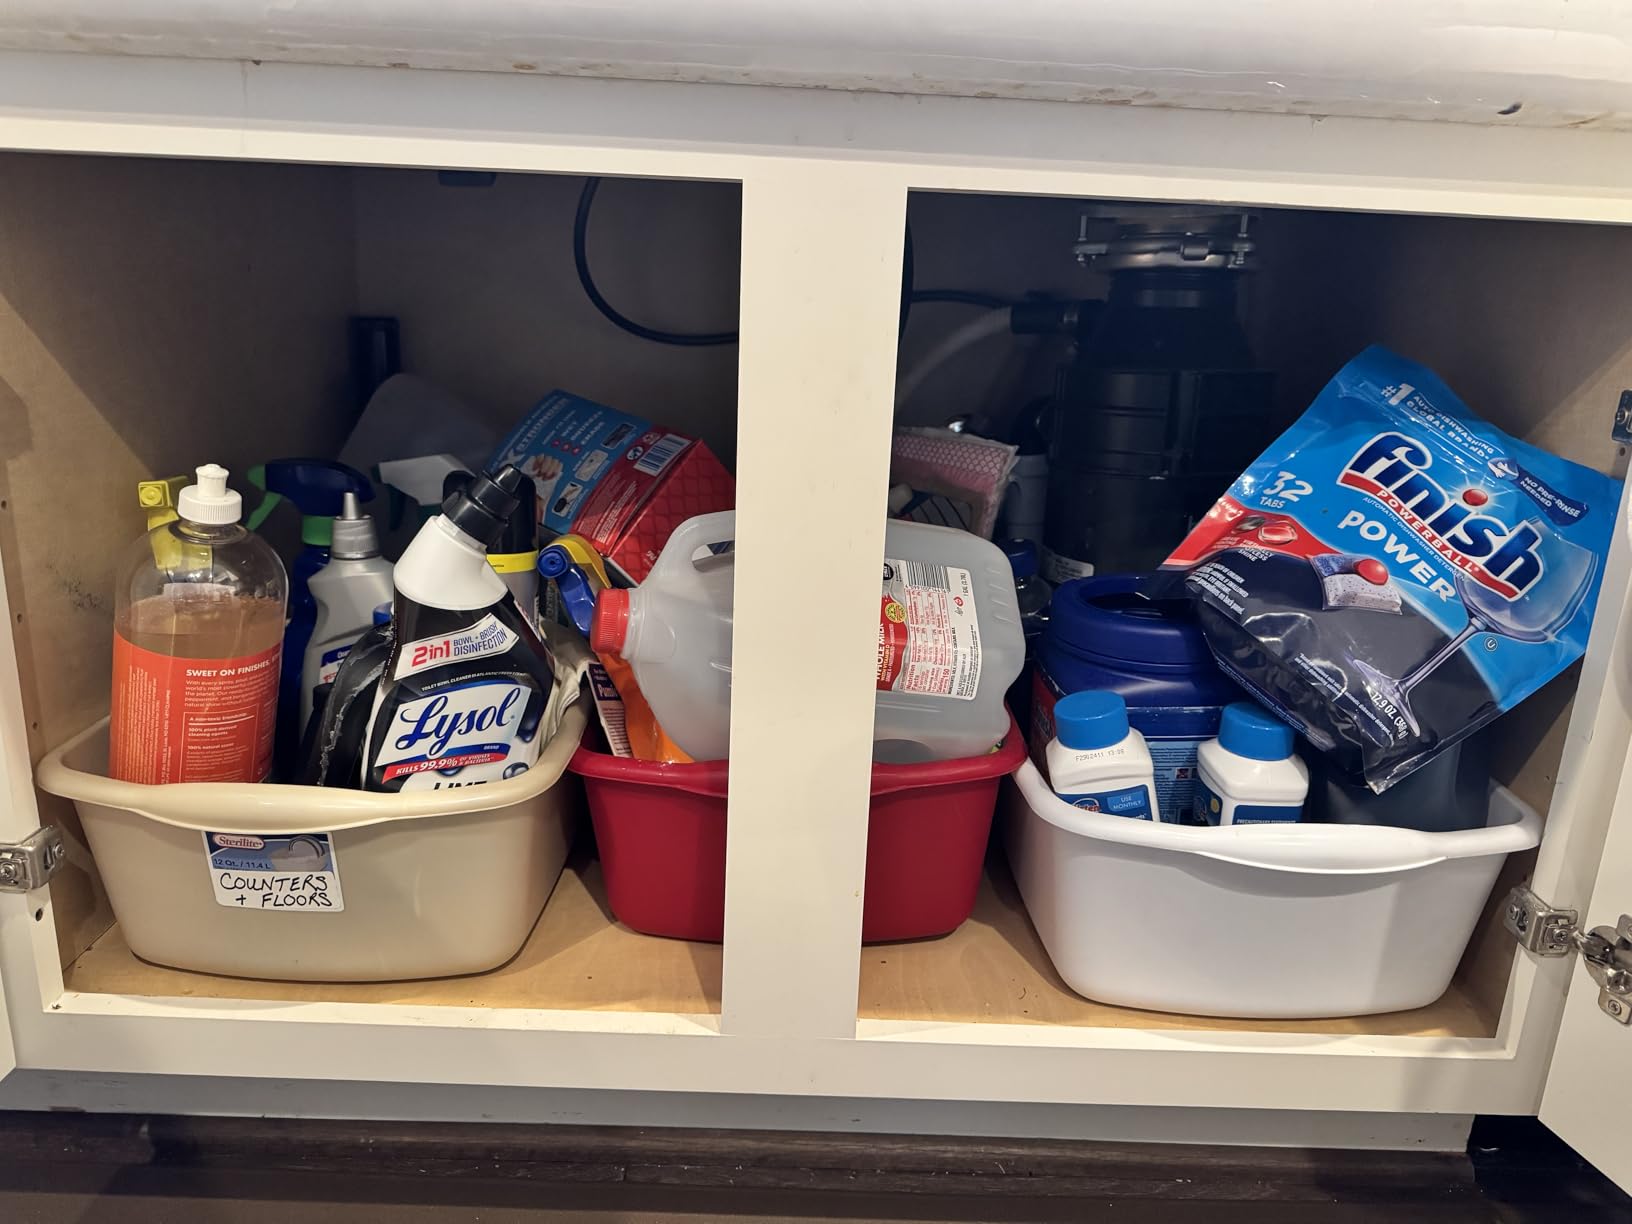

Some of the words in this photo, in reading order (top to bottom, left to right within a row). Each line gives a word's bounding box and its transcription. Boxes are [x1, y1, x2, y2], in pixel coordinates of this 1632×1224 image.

[1380, 383, 1415, 405] #1
[1406, 400, 1446, 431] GLOBAL
[1263, 471, 1313, 502] 32
[1520, 480, 1553, 508] NEEDED
[1524, 476, 1539, 488] NO
[1537, 485, 1581, 518] PRE-RINSE
[1260, 496, 1286, 509] TABS
[1346, 431, 1543, 594] finish
[1362, 496, 1398, 523] AUTOMATIC
[1397, 521, 1435, 557] DISHWASHER
[1433, 553, 1466, 582] DETERGEN
[1376, 488, 1478, 573] POWERBALL
[1238, 549, 1258, 562] SHINE
[1337, 510, 1457, 603] POWER
[1226, 581, 1249, 598] SWALLOWED
[453, 636, 474, 646] BOWL
[480, 621, 498, 640] BRUSH
[453, 628, 508, 657] DISINFECTION
[411, 640, 450, 667] 2in1
[877, 644, 885, 680] WHOLE
[422, 683, 437, 691] TOILET
[450, 673, 473, 683] CLEANER
[906, 664, 915, 690] Nutrition
[395, 687, 521, 756] Lysol
[1384, 702, 1398, 719] OZ.
[396, 765, 418, 776] KILLS
[419, 757, 458, 772] 99.9%
[1113, 801, 1141, 810] MONTHLY
[219, 836, 258, 847] Sterilite
[220, 872, 328, 892] COUNTERS
[235, 894, 247, 905] +
[261, 892, 333, 907] FLOORS
